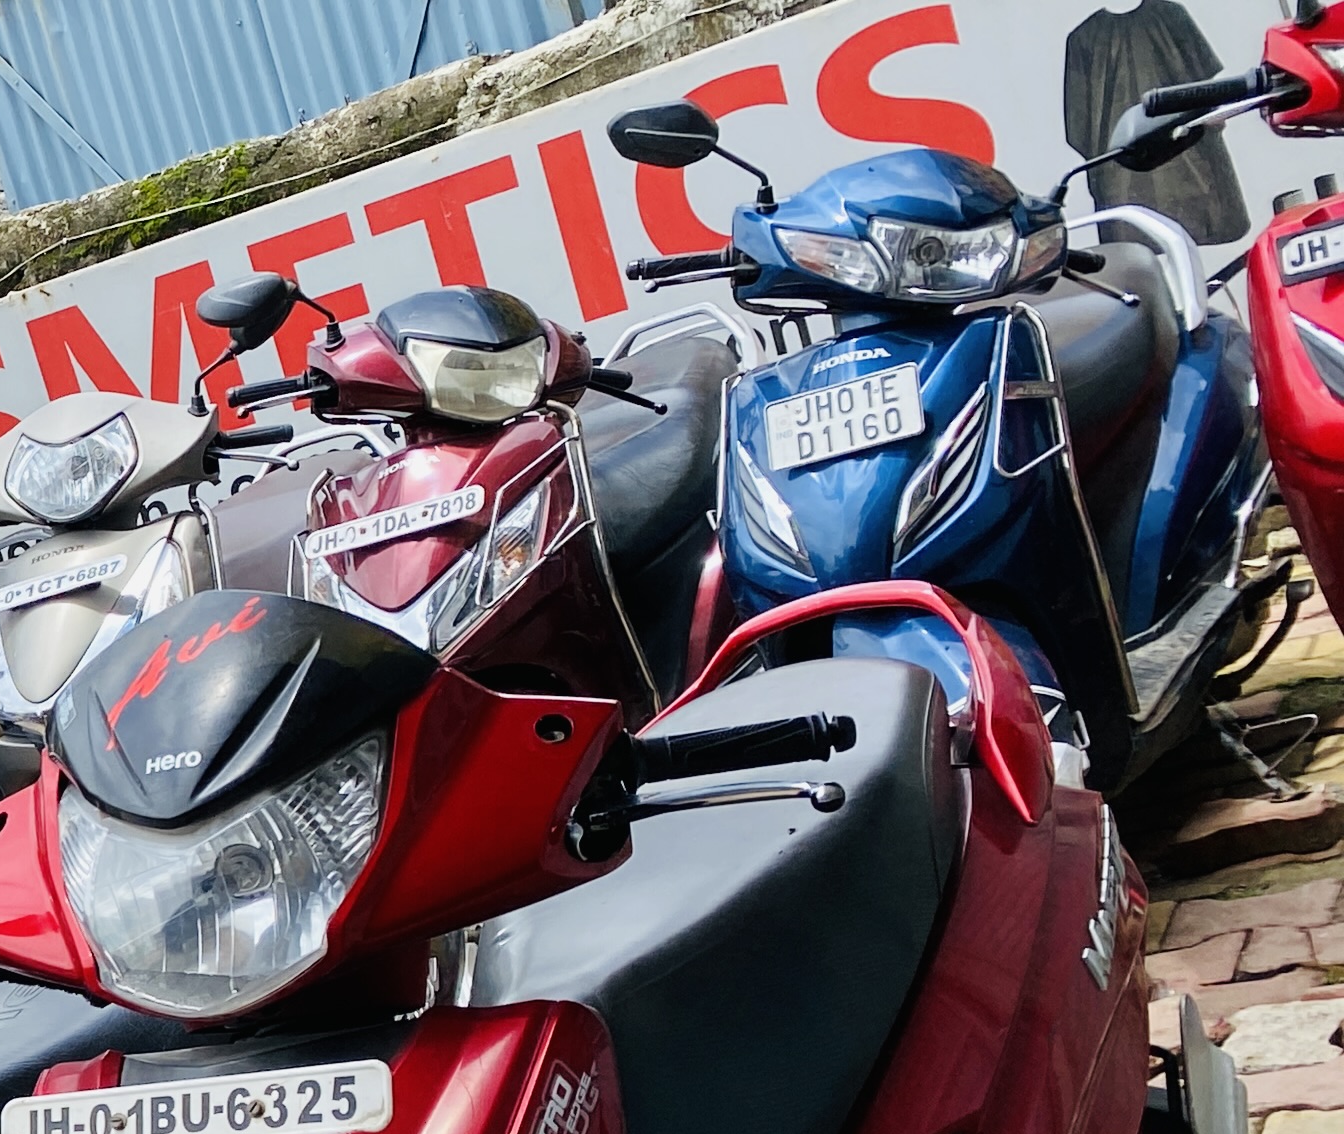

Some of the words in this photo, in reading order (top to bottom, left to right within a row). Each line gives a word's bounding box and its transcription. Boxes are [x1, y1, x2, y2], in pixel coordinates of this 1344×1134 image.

[812, 347, 892, 375] HONDA
[797, 406, 903, 461] D1160
[30, 544, 86, 565] HONDA
[145, 747, 203, 777] Hero
[565, 1070, 592, 1134] EDGE
